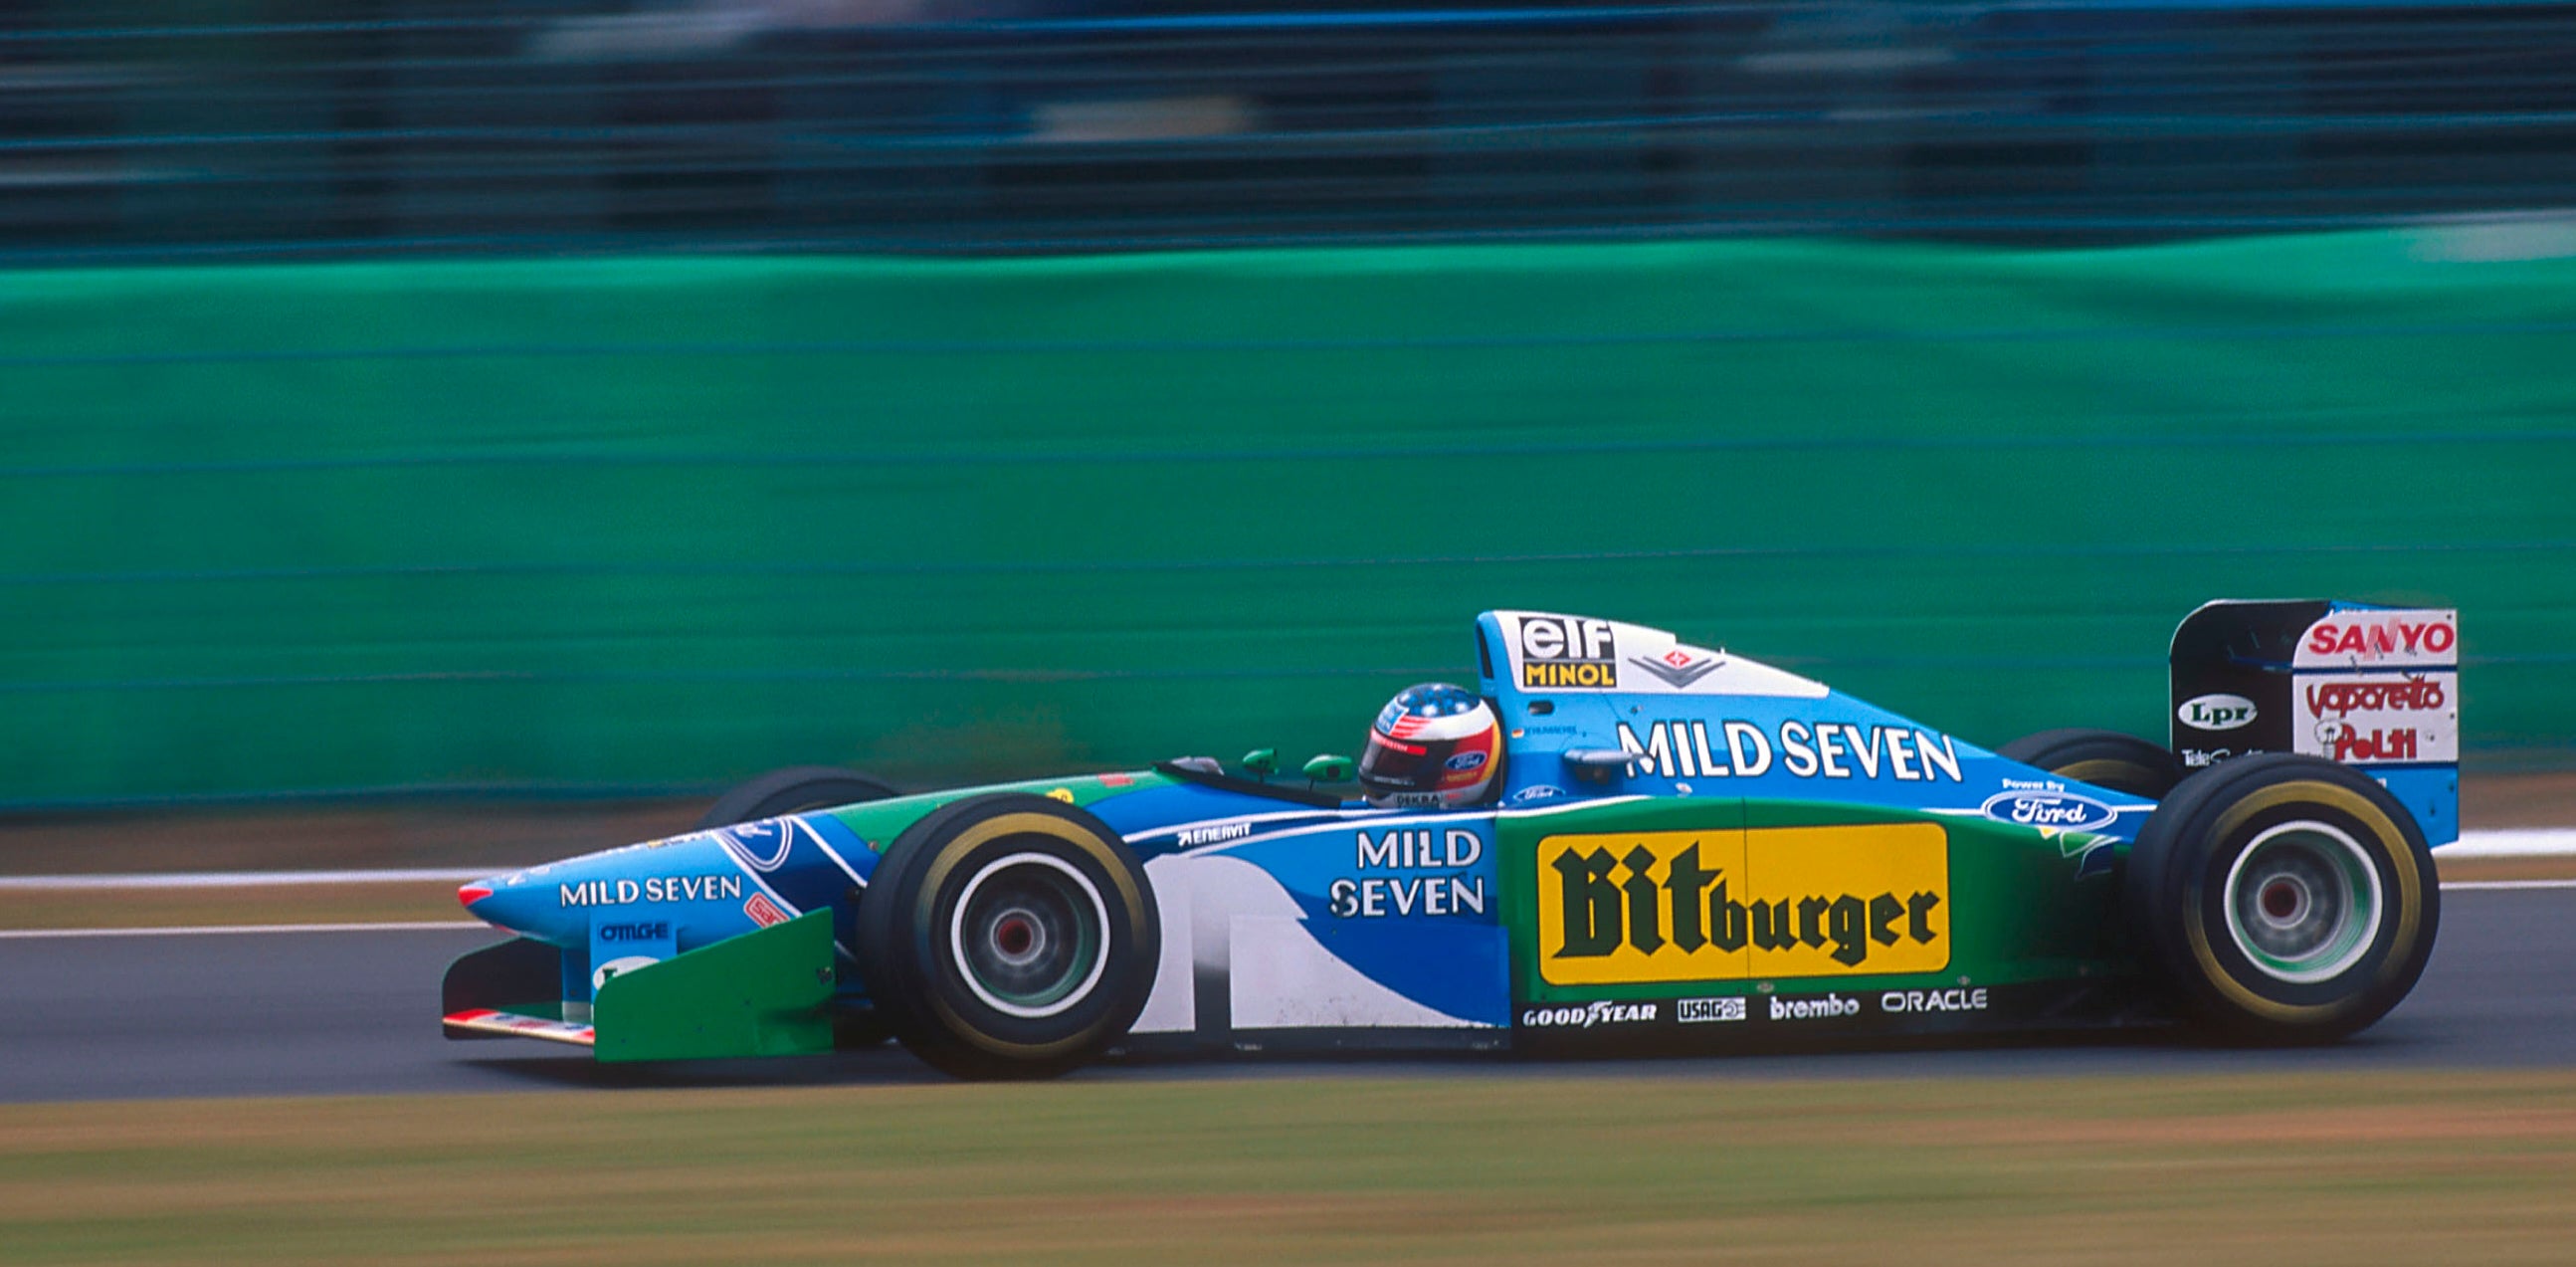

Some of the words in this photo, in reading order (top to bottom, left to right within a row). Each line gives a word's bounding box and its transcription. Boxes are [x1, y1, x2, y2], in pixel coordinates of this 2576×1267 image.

[1522, 618, 1614, 659] elf
[2308, 619, 2455, 660] SANYO
[1525, 663, 1615, 687] MINOL
[2191, 703, 2249, 726] Lpr
[1616, 720, 1774, 778] MILD
[1779, 721, 1965, 783] SEVEN
[2002, 778, 2044, 790] Power
[2046, 780, 2066, 792] By
[2011, 798, 2087, 824] Ford
[1357, 829, 1483, 870] MILD
[559, 878, 640, 908] MILD
[645, 874, 742, 904] SEVEN
[1328, 876, 1486, 919] SEVEN
[1550, 840, 1941, 967] Bitburger
[1680, 1000, 1723, 1019] USAG
[1769, 993, 1861, 1021] brembo
[1881, 988, 1988, 1013] ORACLE
